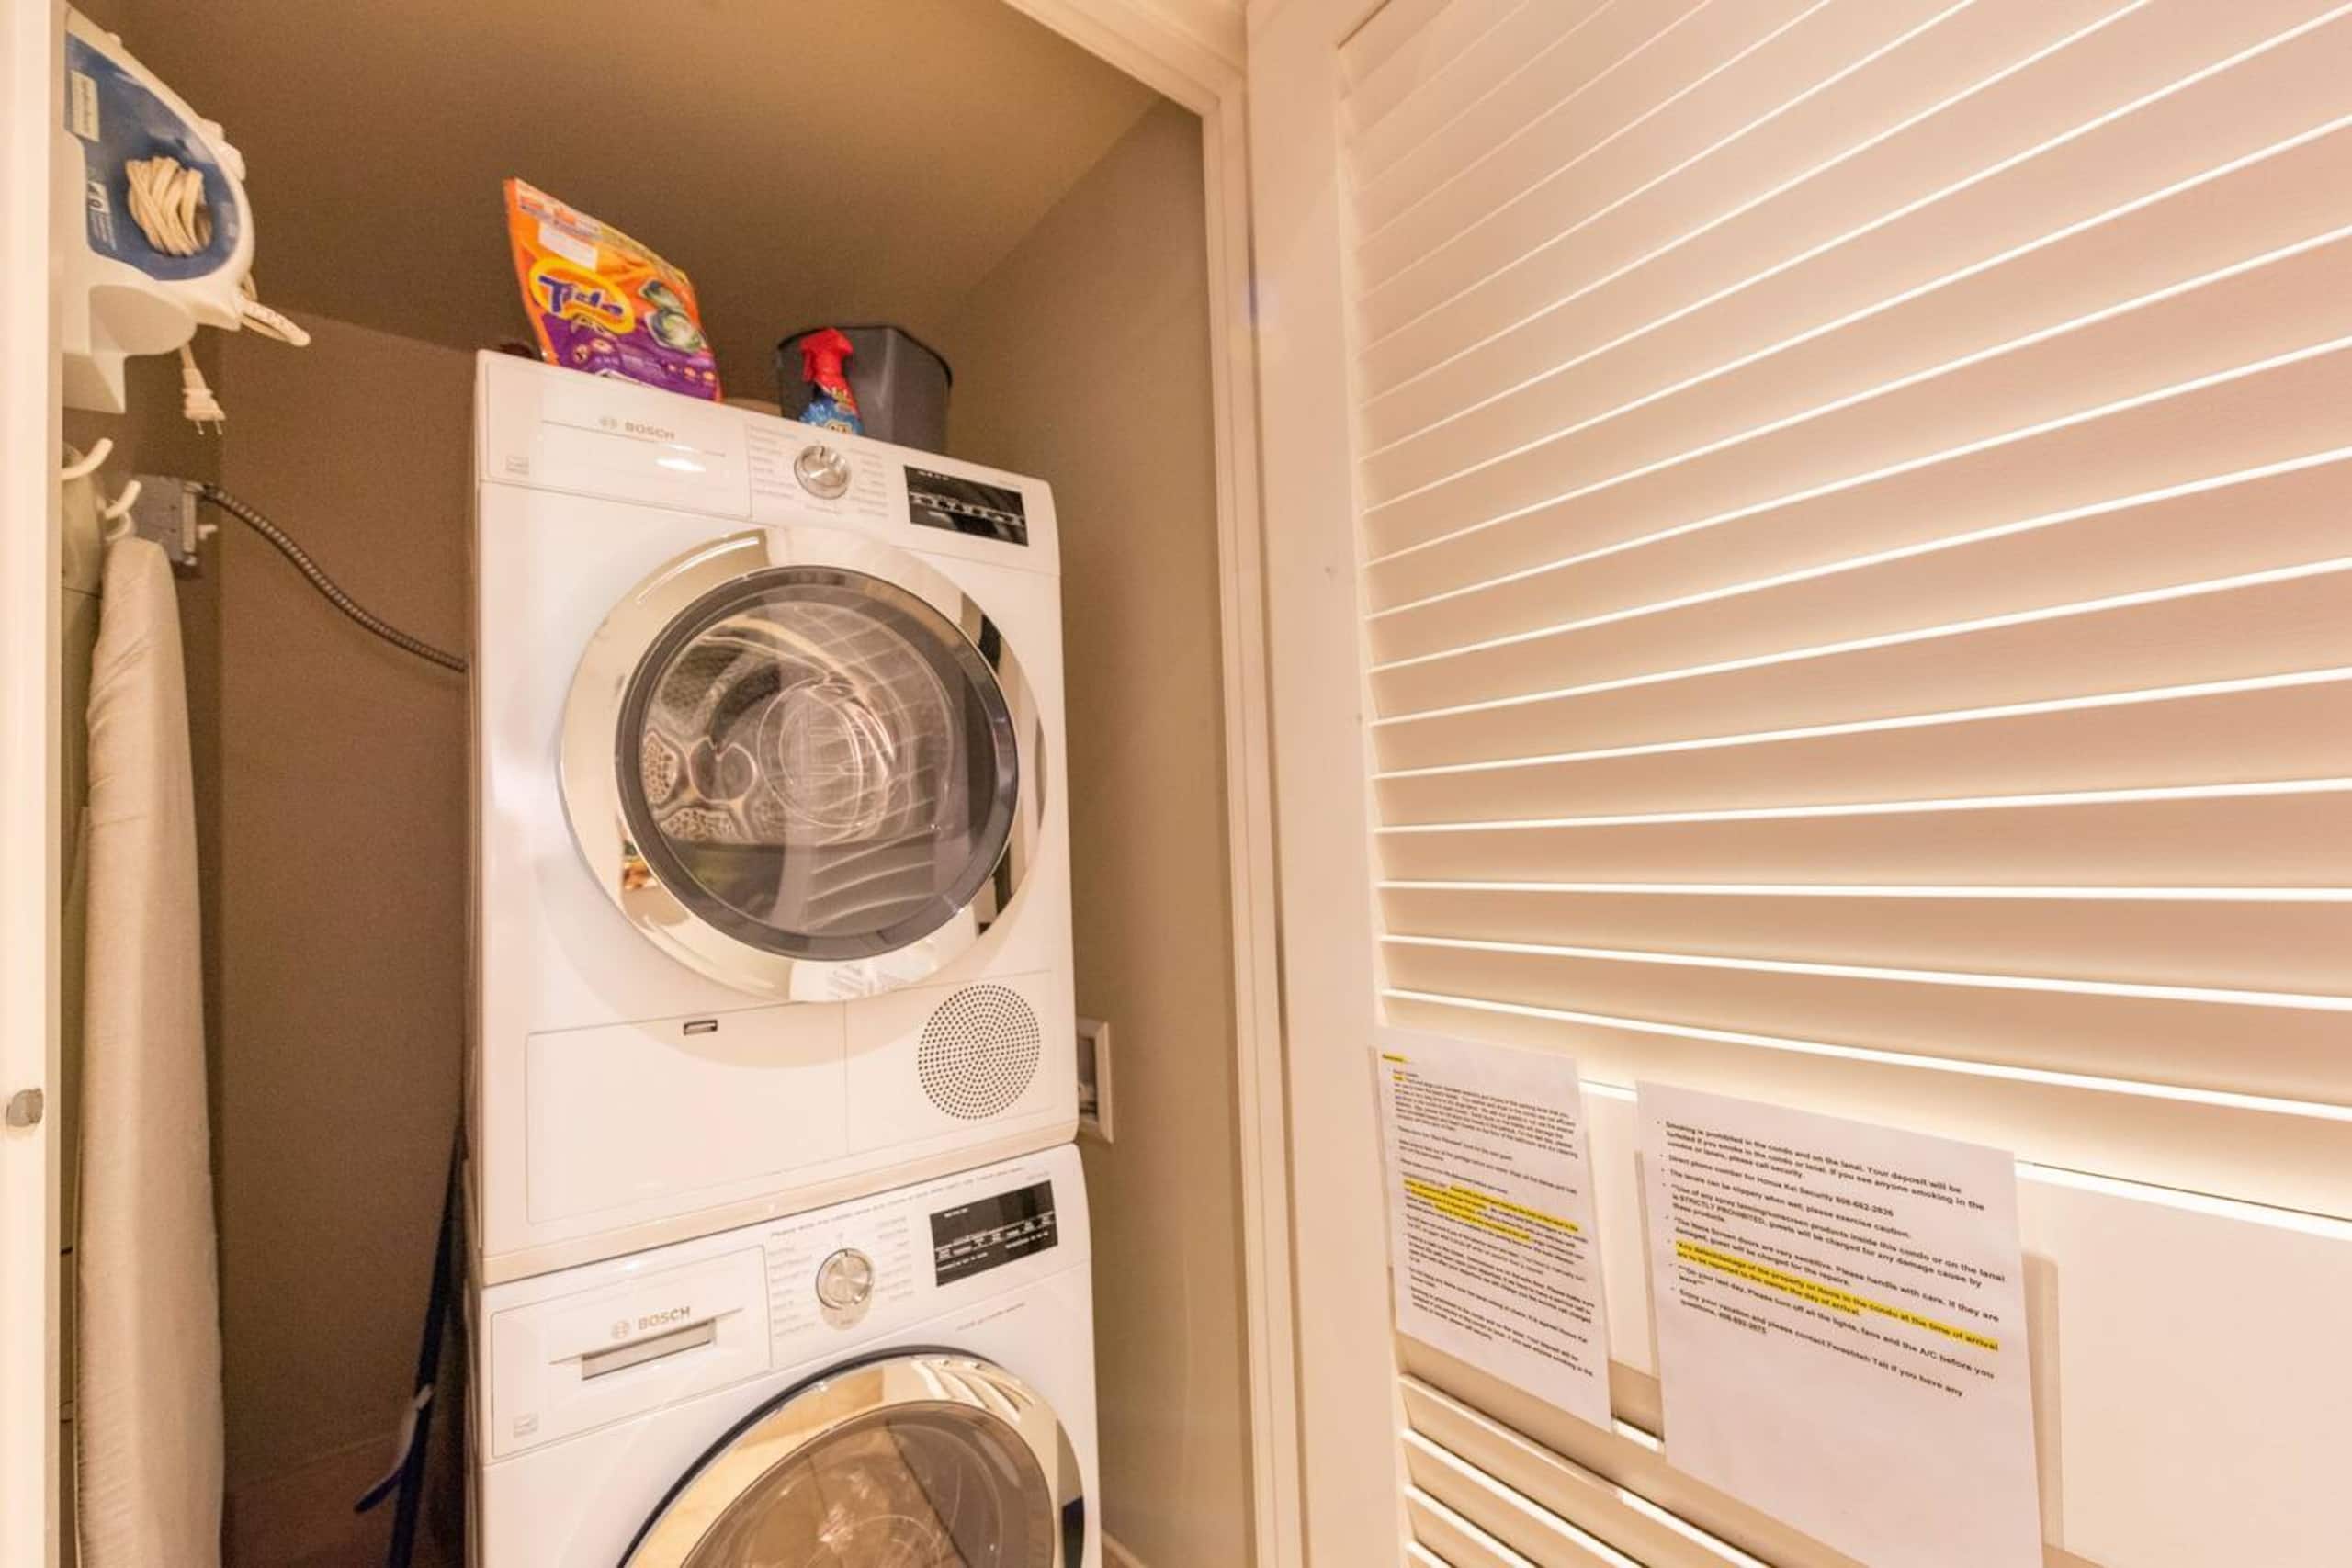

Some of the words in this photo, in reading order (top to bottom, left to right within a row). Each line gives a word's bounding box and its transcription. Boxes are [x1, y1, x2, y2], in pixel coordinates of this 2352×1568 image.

[538, 274, 625, 313] Tide
[625, 422, 675, 440] BOSCH
[1690, 1162, 1712, 1170] phone
[1715, 1168, 1742, 1178] number
[1800, 1189, 1832, 1201] Security
[1706, 1132, 1742, 1143] prohibited
[1768, 1145, 1792, 1155] condo
[1867, 1167, 1888, 1177] Your
[1892, 1172, 1926, 1185] deposit
[1949, 1185, 1961, 1193] be
[1719, 1145, 1742, 1153] smoke
[1768, 1156, 1792, 1165] condo
[1875, 1181, 1907, 1191] anyone
[1911, 1190, 1952, 1204] smoking
[1969, 1201, 1984, 1210] the
[1715, 1198, 1735, 1207] spray
[1811, 1224, 1847, 1237] products
[1851, 1234, 1876, 1246] inside
[1880, 1242, 1896, 1251] this
[1900, 1249, 1928, 1260] condo
[1962, 1264, 1976, 1273] the
[1733, 1187, 1762, 1199] slippery
[1765, 1196, 1784, 1204] when
[1807, 1207, 1832, 1217] please
[1836, 1214, 1871, 1227] exercise
[1680, 1196, 1714, 1210] STRICTLY
[1770, 1223, 1794, 1233] guests
[1826, 1238, 1860, 1251] charged
[1862, 1247, 1874, 1256] for
[1878, 1253, 1893, 1262] any
[1897, 1257, 1933, 1272] damage
[1938, 1270, 1965, 1281] cause
[1970, 1278, 1981, 1288] by
[1758, 1253, 1788, 1266] charged
[1804, 1267, 1815, 1275] the
[1709, 1261, 1738, 1274] reported
[1749, 1274, 1761, 1282] the
[1790, 1287, 1801, 1295] the
[1804, 1292, 1817, 1303] day
[1712, 1228, 1735, 1240] Screen
[1738, 1236, 1758, 1247] doors
[1777, 1249, 1792, 1258] very
[1837, 1266, 1863, 1280] Please
[1867, 1275, 1897, 1290] handle
[1900, 1287, 1919, 1296] with
[1959, 1303, 1979, 1317] they
[1984, 1313, 1999, 1321] are
[1758, 1267, 1769, 1275] the
[1771, 1273, 1804, 1288] property
[1818, 1286, 1839, 1298] items
[1853, 1298, 1866, 1307] the
[1870, 1304, 1897, 1317] condo
[1911, 1316, 1925, 1326] the
[1929, 1322, 1949, 1334] time
[639, 1305, 691, 1331] BOSCH
[1680, 1289, 1698, 1301] Enjoy
[1720, 1304, 1749, 1317] vacation
[1769, 1322, 1792, 1334] please
[1795, 1332, 1825, 1346] contact
[1900, 1370, 1917, 1379] you
[1919, 1375, 1942, 1388] have
[1946, 1386, 1962, 1398] any
[1716, 1278, 1728, 1286] last
[1748, 1289, 1772, 1301] Please
[1775, 1298, 1791, 1307] turn
[1817, 1313, 1830, 1321] the
[1861, 1327, 1880, 1338] fans
[1883, 1337, 1899, 1346] and
[1902, 1341, 1917, 1351] the
[1920, 1348, 1936, 1359] A/C
[1940, 1355, 1972, 1371] before
[1975, 1368, 1994, 1378] you
